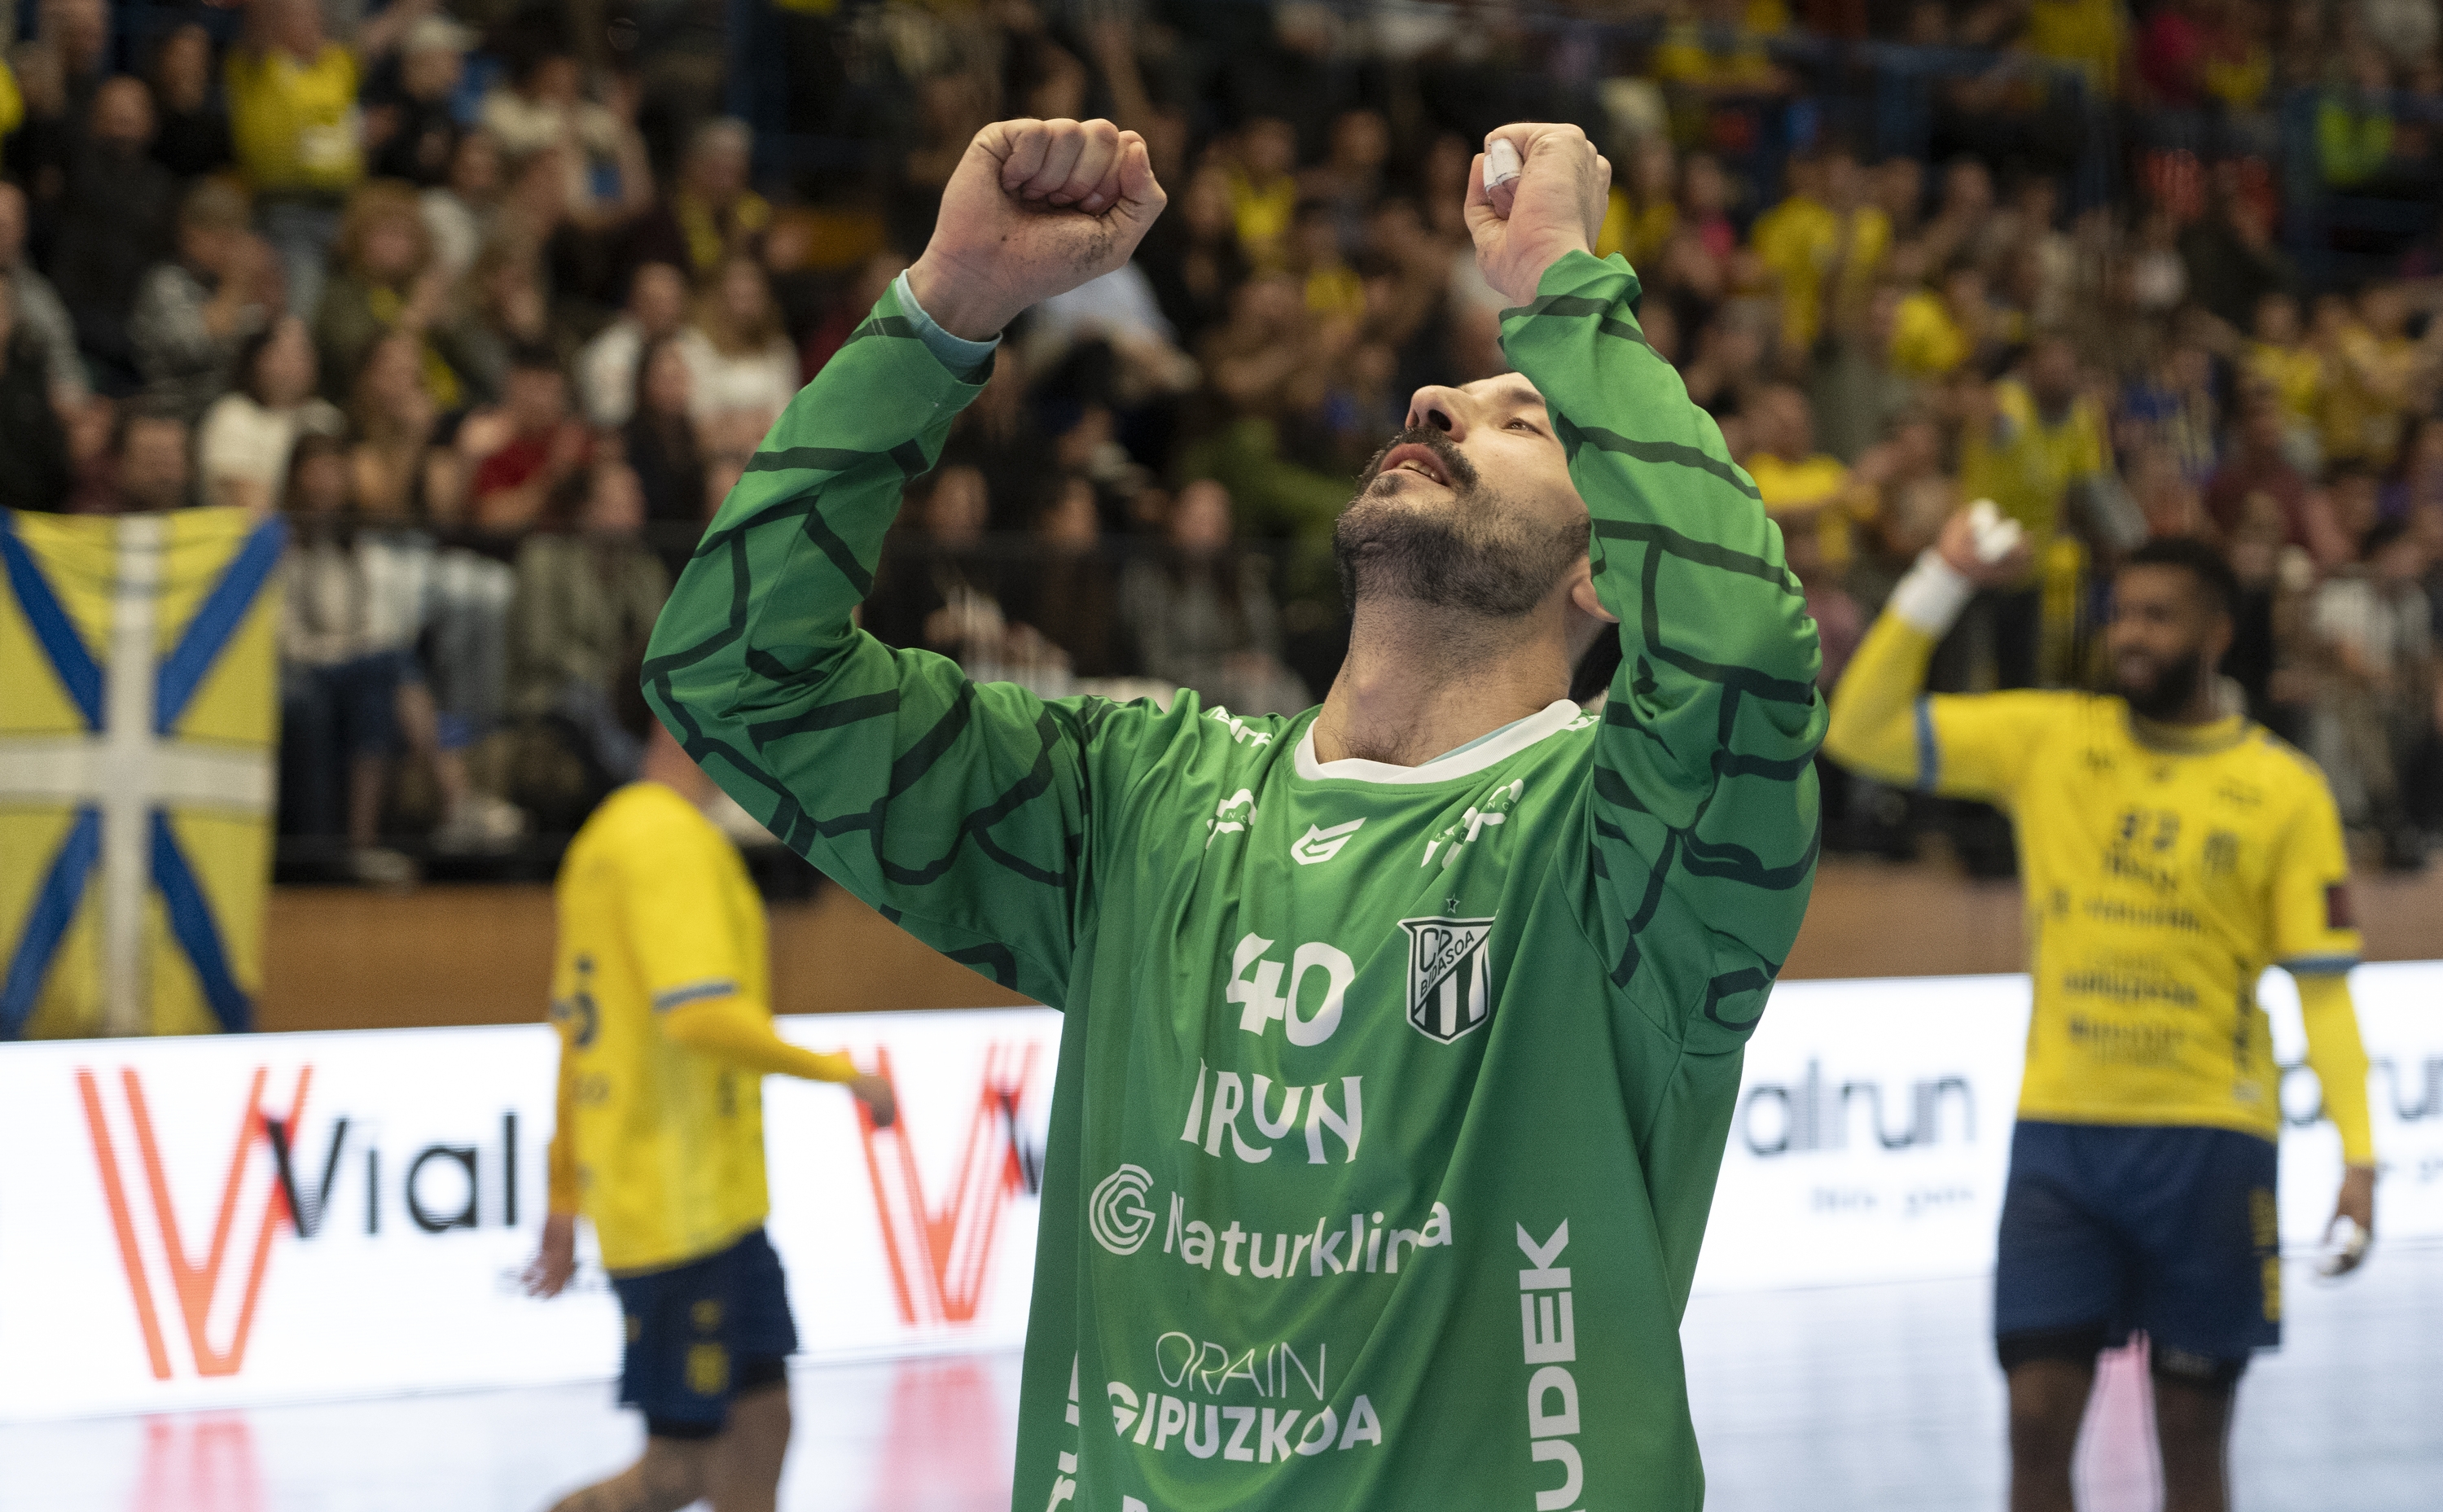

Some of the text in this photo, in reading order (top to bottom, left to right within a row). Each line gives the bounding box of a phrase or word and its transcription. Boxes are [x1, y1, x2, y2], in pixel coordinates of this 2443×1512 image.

[1225, 931, 1356, 1047] 40
[1419, 927, 1454, 972] CD
[1419, 930, 1476, 998] BIDASOA
[1180, 1056, 1364, 1164] IRUN
[1155, 1330, 1327, 1401] ORAIN
[1515, 1216, 1586, 1512] UDEK
[1106, 1381, 1383, 1464] GIPUZKOA
